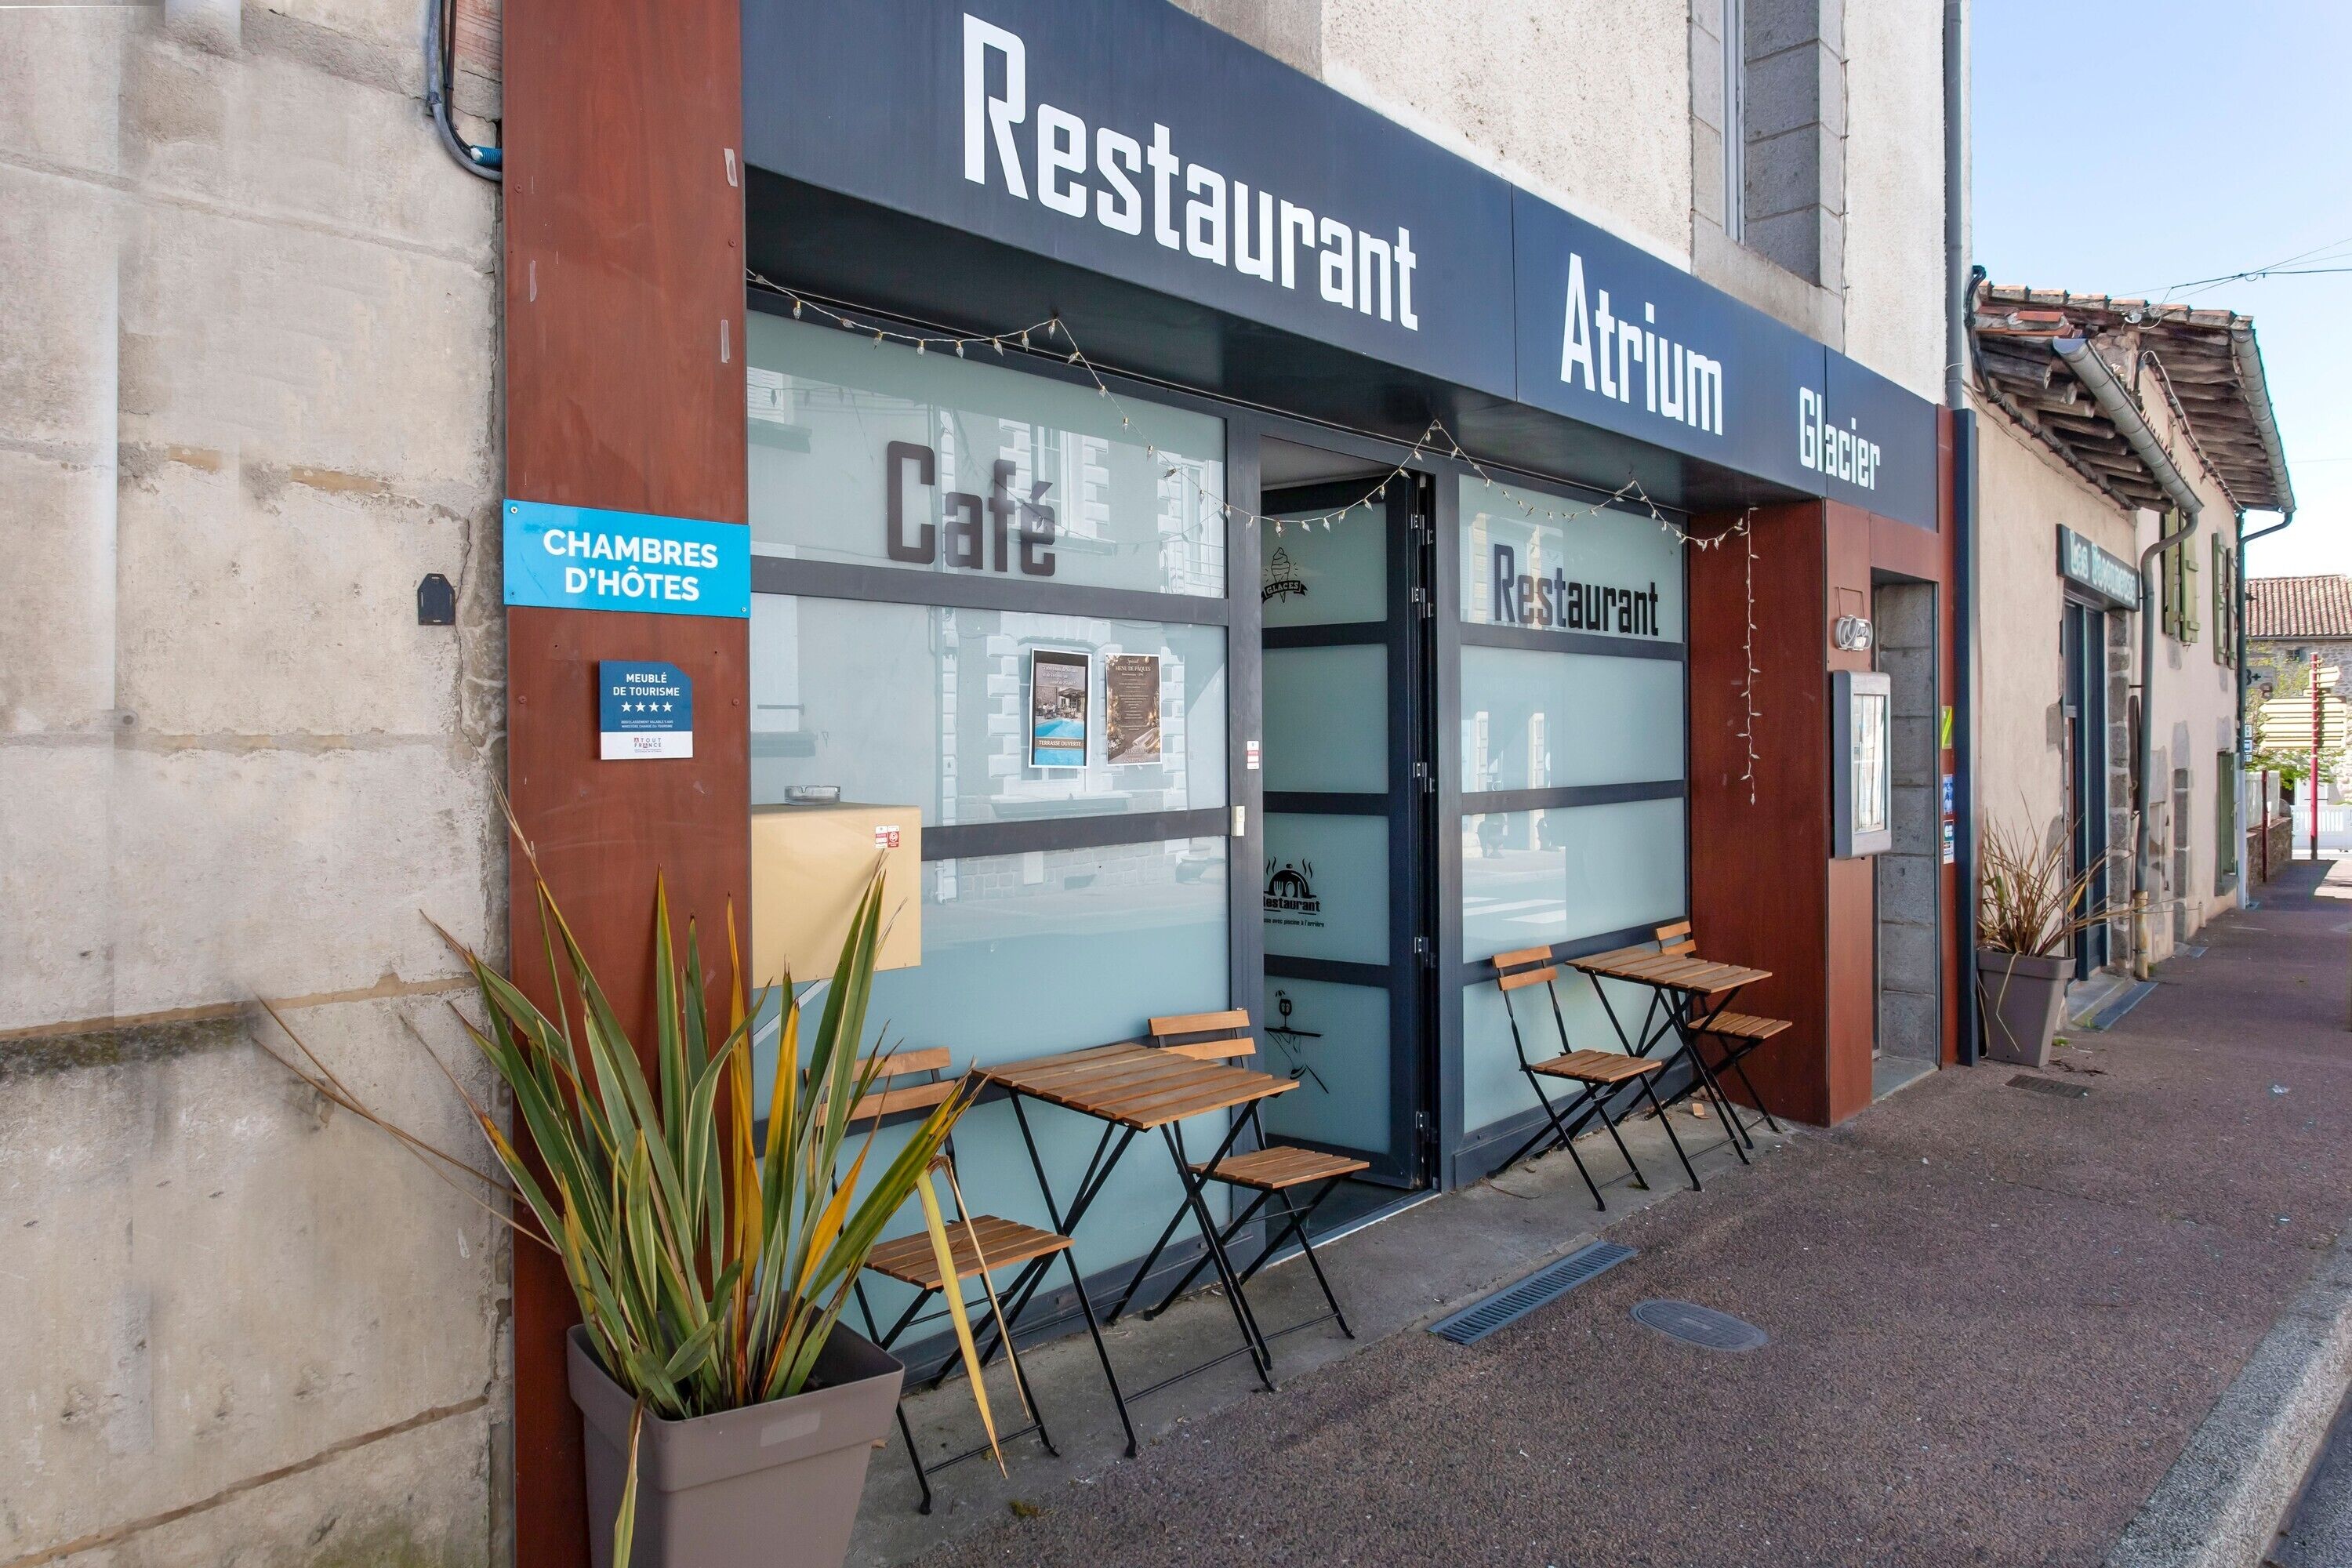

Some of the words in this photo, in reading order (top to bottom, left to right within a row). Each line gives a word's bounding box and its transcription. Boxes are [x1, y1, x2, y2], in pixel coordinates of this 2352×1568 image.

[964, 13, 1418, 332] Restaurant
[1560, 252, 1722, 436] Atrium
[1799, 387, 1881, 491] Glacier
[887, 441, 1055, 577] Café
[543, 528, 719, 568] CHAMBRES
[565, 565, 699, 601] D'HÔTES
[1265, 581, 1299, 594] GLACES
[1494, 543, 1659, 637] Restaurant
[613, 686, 626, 696] DE
[630, 686, 680, 696] TOURISME
[626, 672, 667, 683] MEUBLÉ
